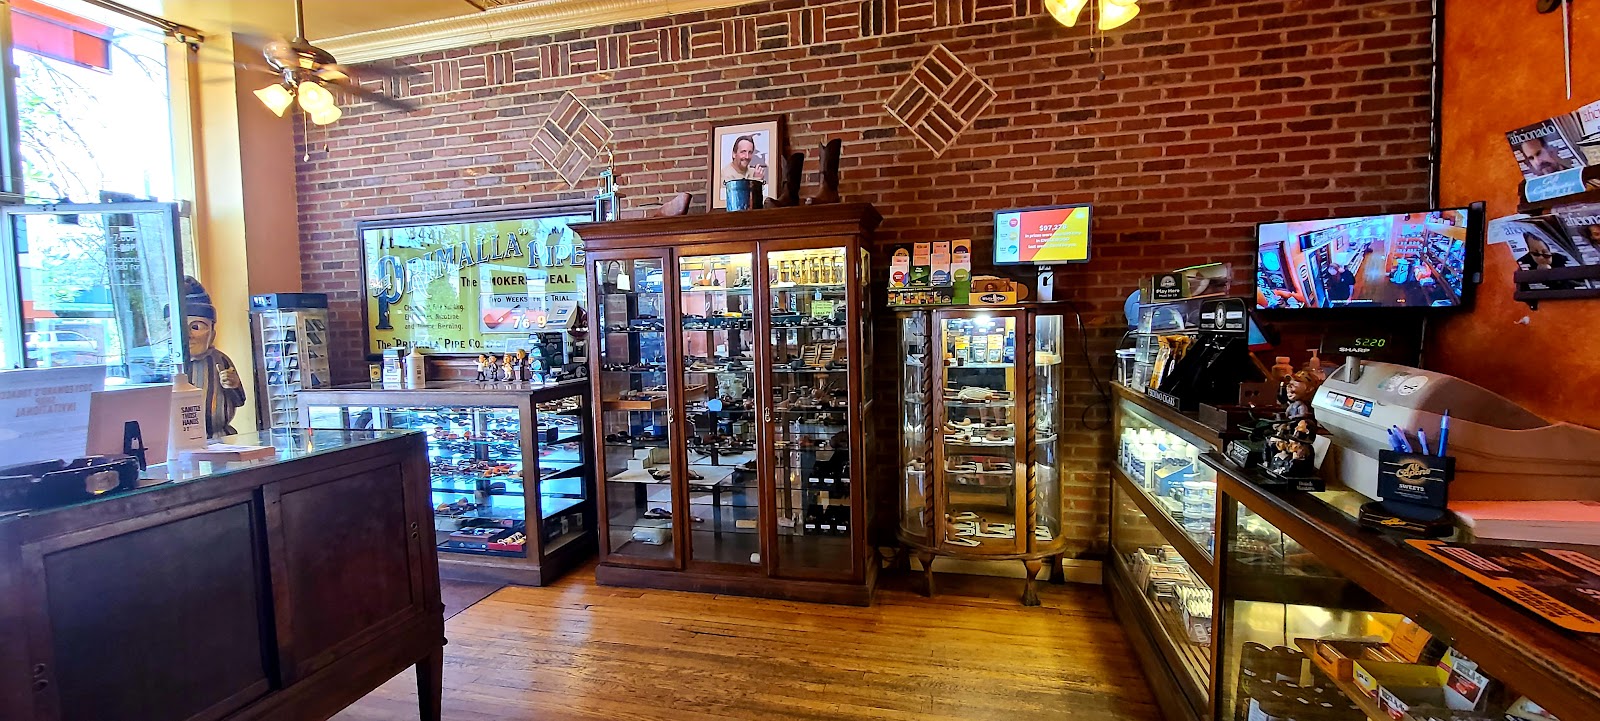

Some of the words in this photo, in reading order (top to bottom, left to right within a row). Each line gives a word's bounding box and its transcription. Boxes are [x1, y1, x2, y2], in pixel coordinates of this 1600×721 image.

[1510, 122, 1556, 145] aficionado
[527, 239, 586, 269] PIPE
[461, 276, 478, 288] The
[505, 295, 528, 303] WEEKS
[376, 339, 392, 350] The
[445, 339, 465, 349] PIPE
[183, 418, 199, 426] HANDS
[1399, 483, 1425, 492] SWEETS
